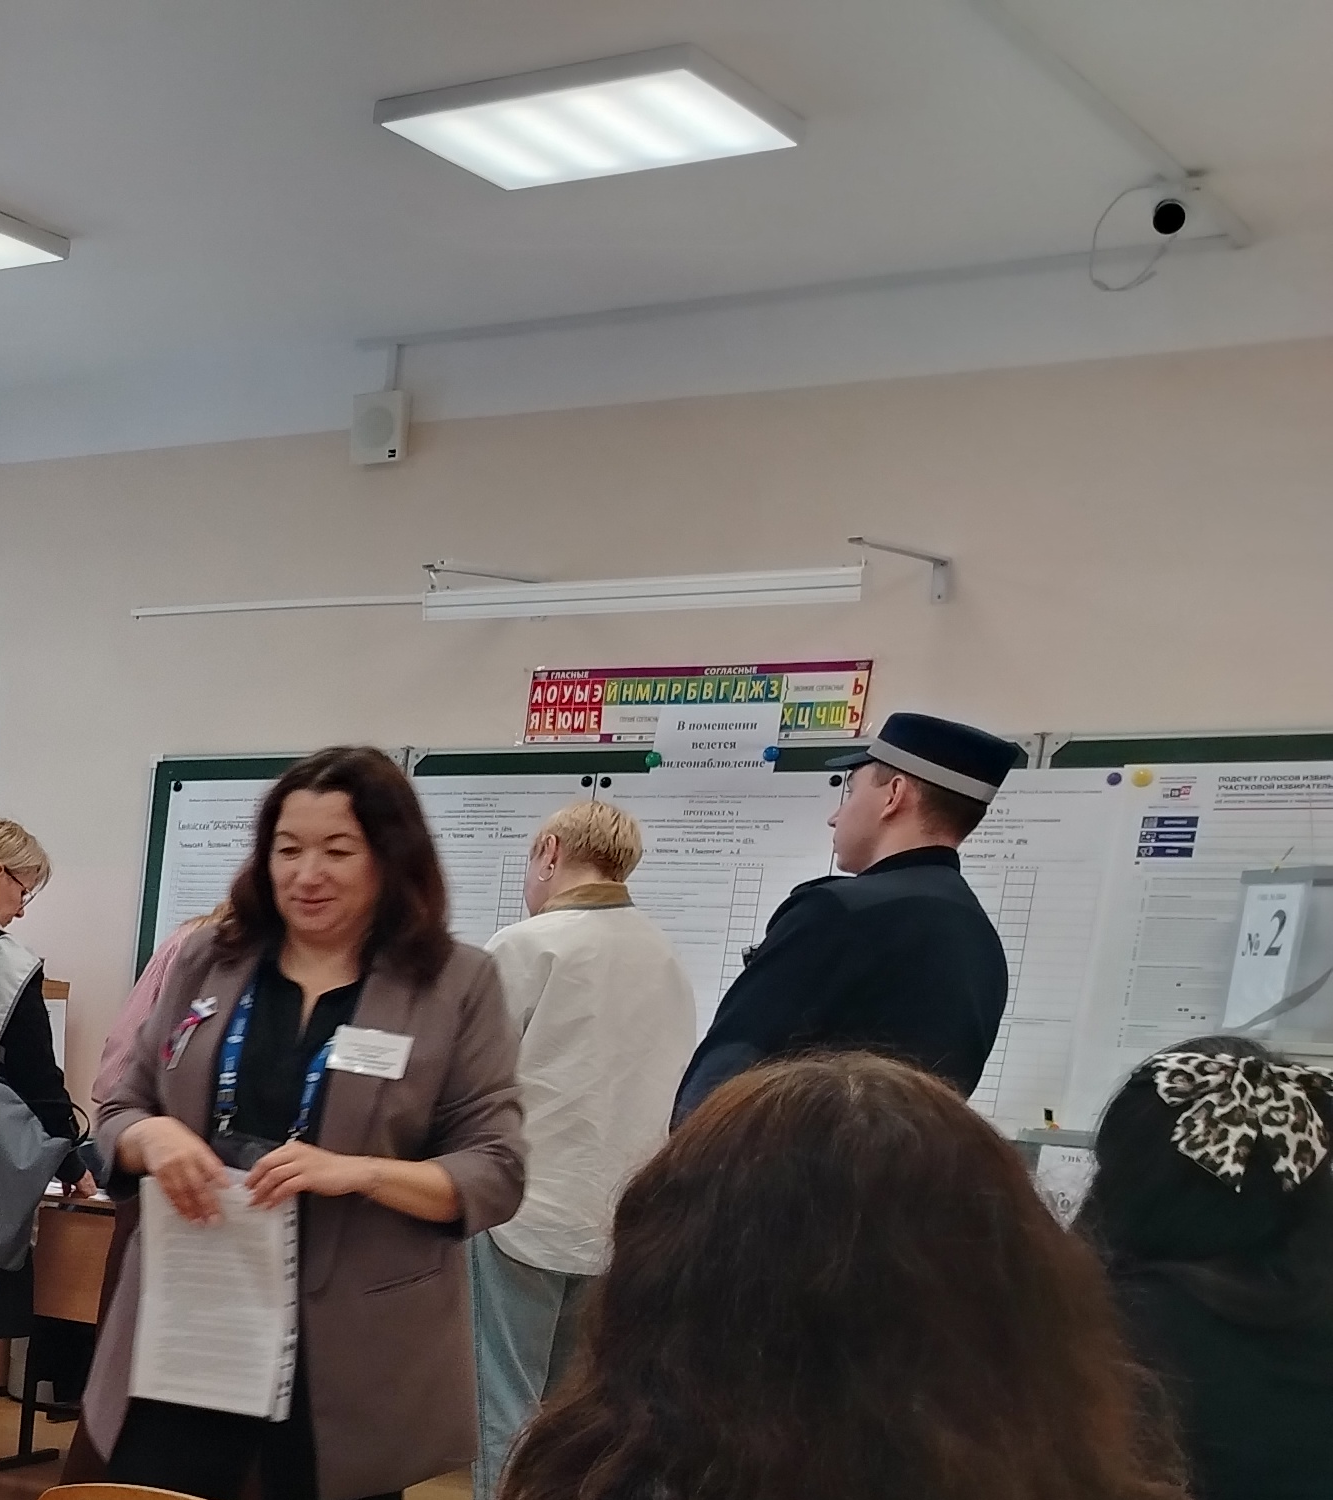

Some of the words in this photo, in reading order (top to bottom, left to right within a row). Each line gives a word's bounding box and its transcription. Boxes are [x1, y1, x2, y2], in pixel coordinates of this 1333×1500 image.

[704, 666, 758, 675] СОГЛАСНЫЕ
[550, 671, 589, 680] ГЛАСНЫЕ
[677, 721, 685, 730] В
[688, 721, 758, 731] помещении
[691, 741, 737, 749] ведется
[659, 758, 766, 768] видеонаблюдение
[1241, 932, 1261, 956] №
[1263, 909, 1287, 956] 2
